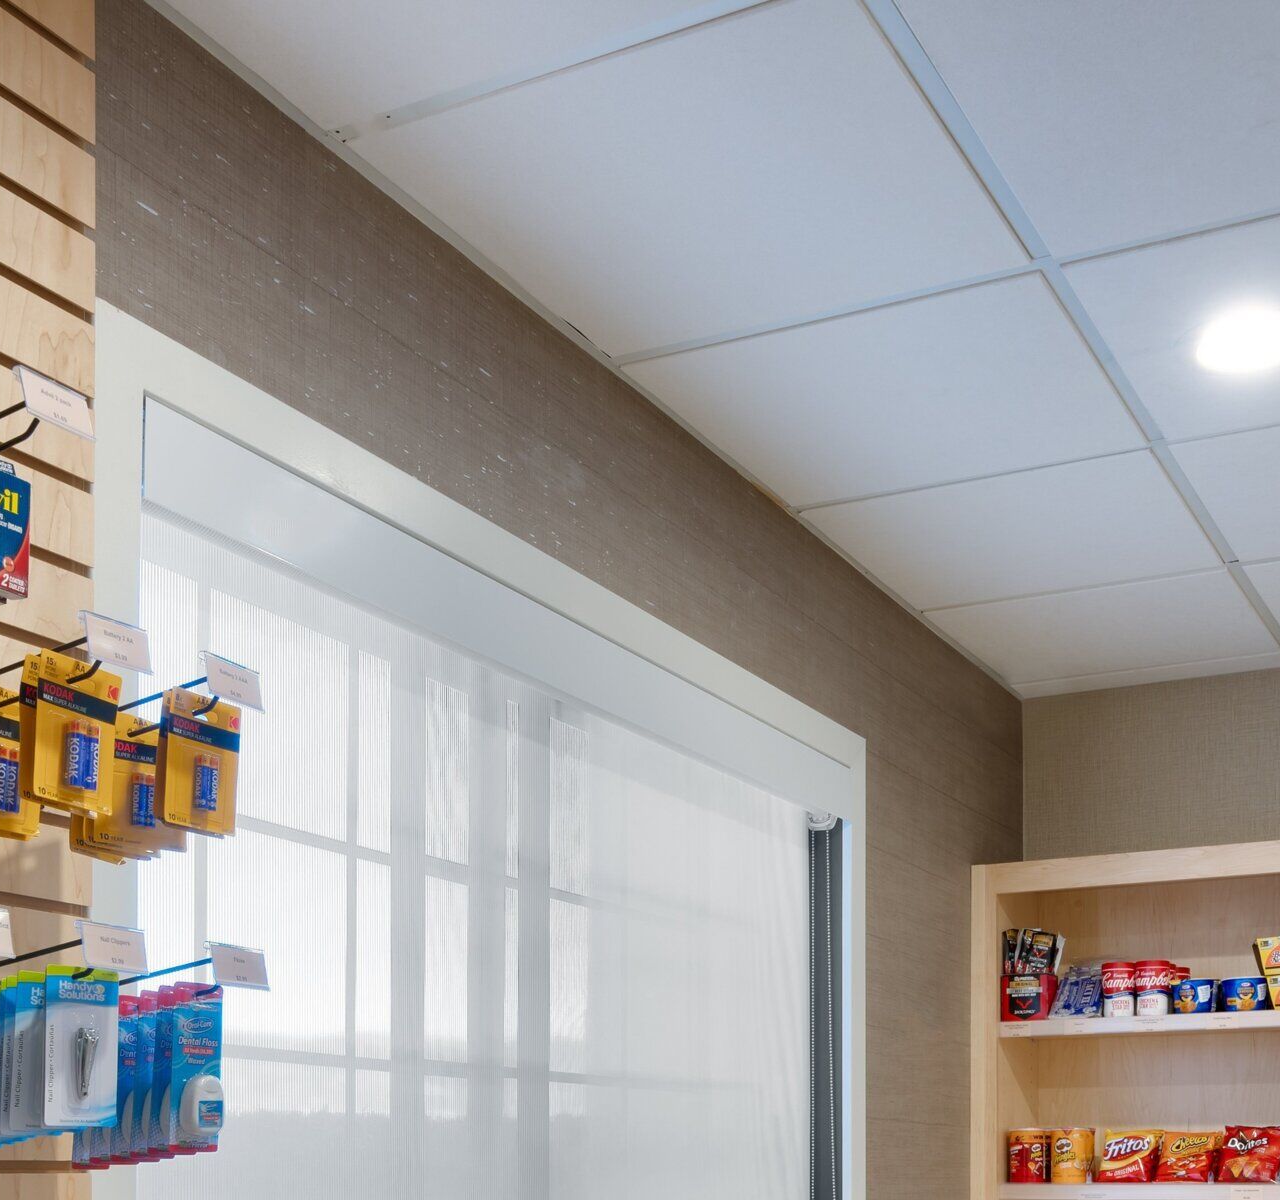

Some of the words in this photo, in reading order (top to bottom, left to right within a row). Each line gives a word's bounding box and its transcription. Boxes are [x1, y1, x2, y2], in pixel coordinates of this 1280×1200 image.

[59, 989, 105, 1001] Solutions
[178, 1036, 201, 1047] Dental
[202, 1038, 218, 1048] Floss
[1103, 1133, 1151, 1163] Fritos
[1170, 1136, 1210, 1153] Cheetos
[1227, 1136, 1268, 1152] Doritos
[1053, 1151, 1076, 1165] Pringles
[1115, 1165, 1139, 1175] ORIGINAL
